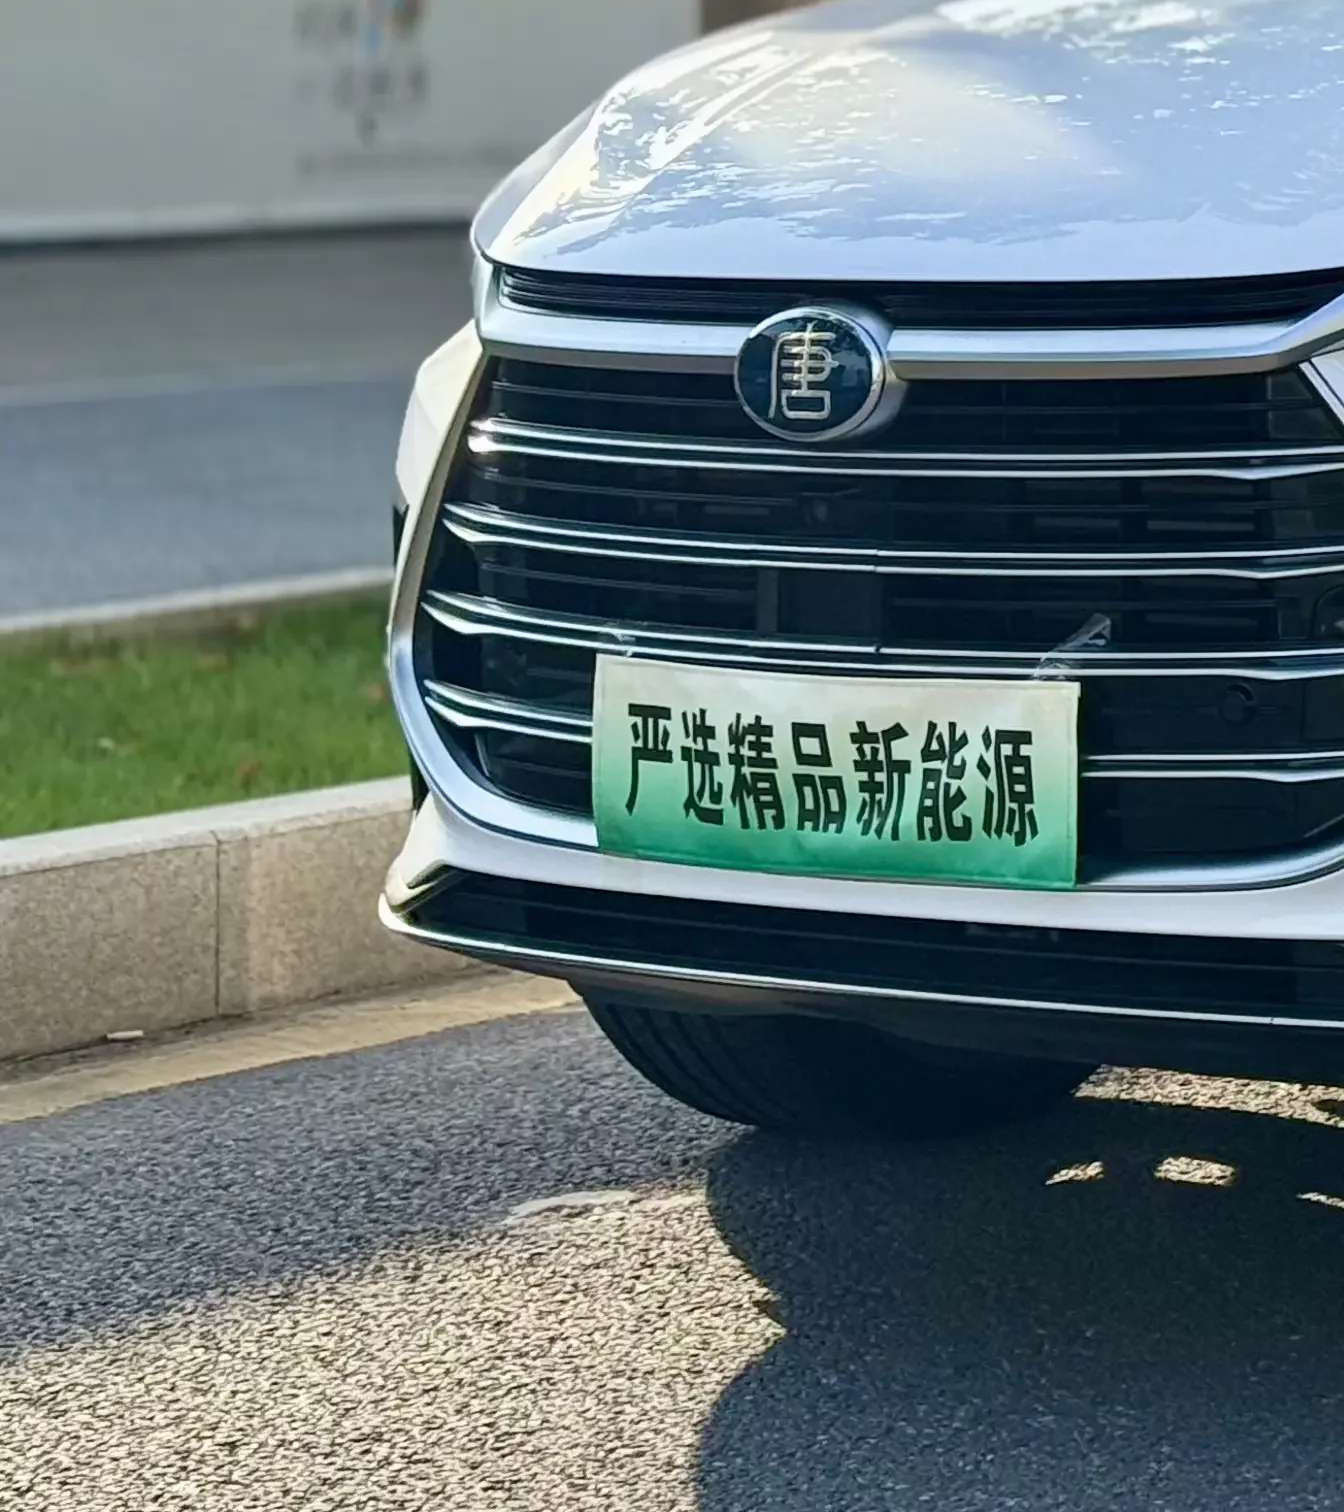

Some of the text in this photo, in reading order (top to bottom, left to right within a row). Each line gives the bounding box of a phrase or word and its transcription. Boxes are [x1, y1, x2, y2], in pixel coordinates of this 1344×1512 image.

[767, 320, 839, 419] 唐
[625, 702, 1039, 848] 严选精品新能源
